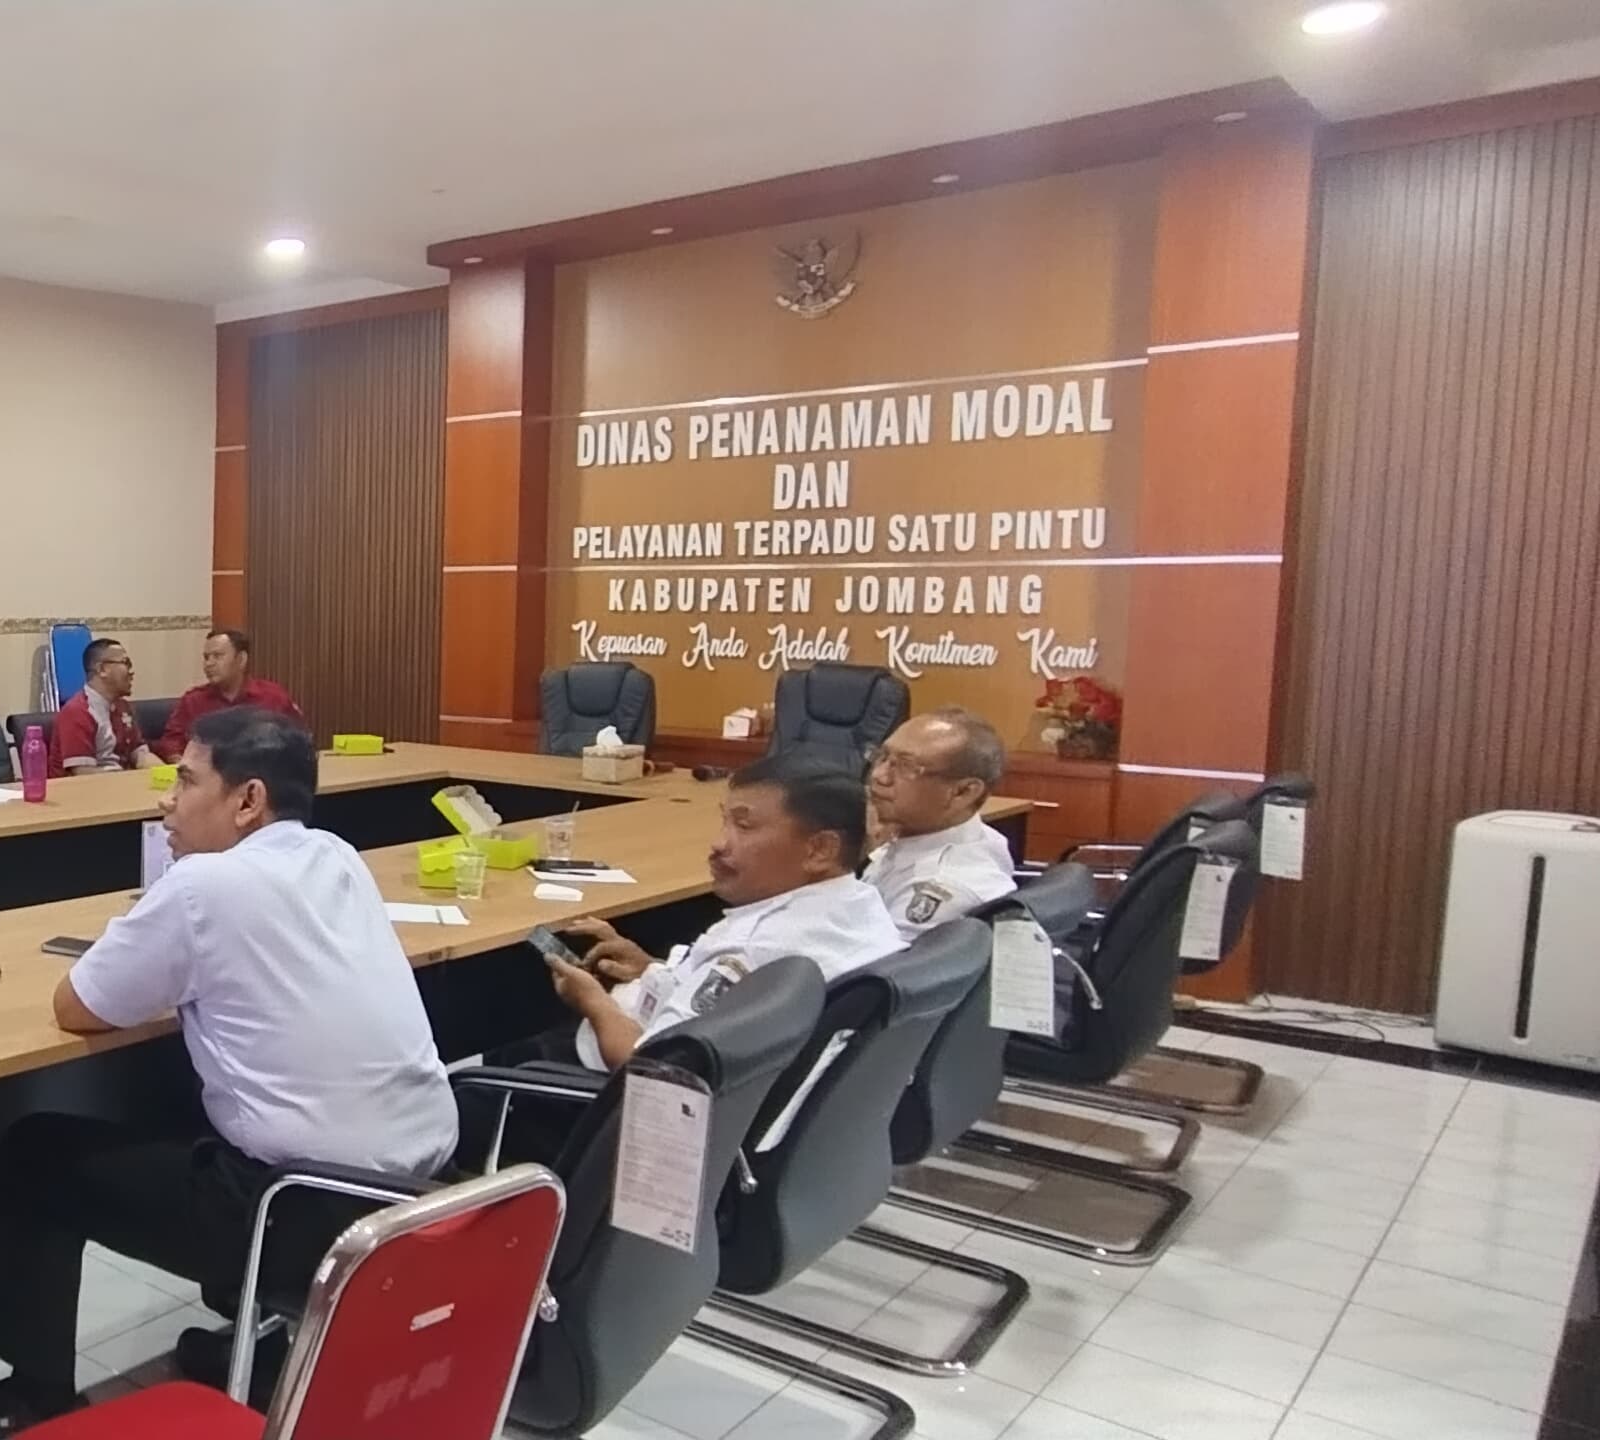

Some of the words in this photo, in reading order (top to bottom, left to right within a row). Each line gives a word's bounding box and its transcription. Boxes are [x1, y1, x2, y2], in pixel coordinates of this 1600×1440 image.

[576, 416, 673, 467] DINAS
[688, 395, 932, 460] PENANAMAN
[950, 377, 1114, 443] MODAL
[772, 460, 850, 511] DAN
[572, 523, 723, 560] PELAYANAN
[734, 517, 875, 557] TERPADU
[887, 511, 977, 554] SATU
[990, 507, 1107, 552] PINTU
[608, 576, 812, 613] KABUPATEN
[835, 574, 1043, 615] JOMBANG
[572, 620, 666, 663] Kepuasan
[681, 621, 749, 671] Anda
[758, 622, 850, 671] Adalah
[875, 622, 999, 680] Komitmen
[1016, 623, 1099, 681] Kami
